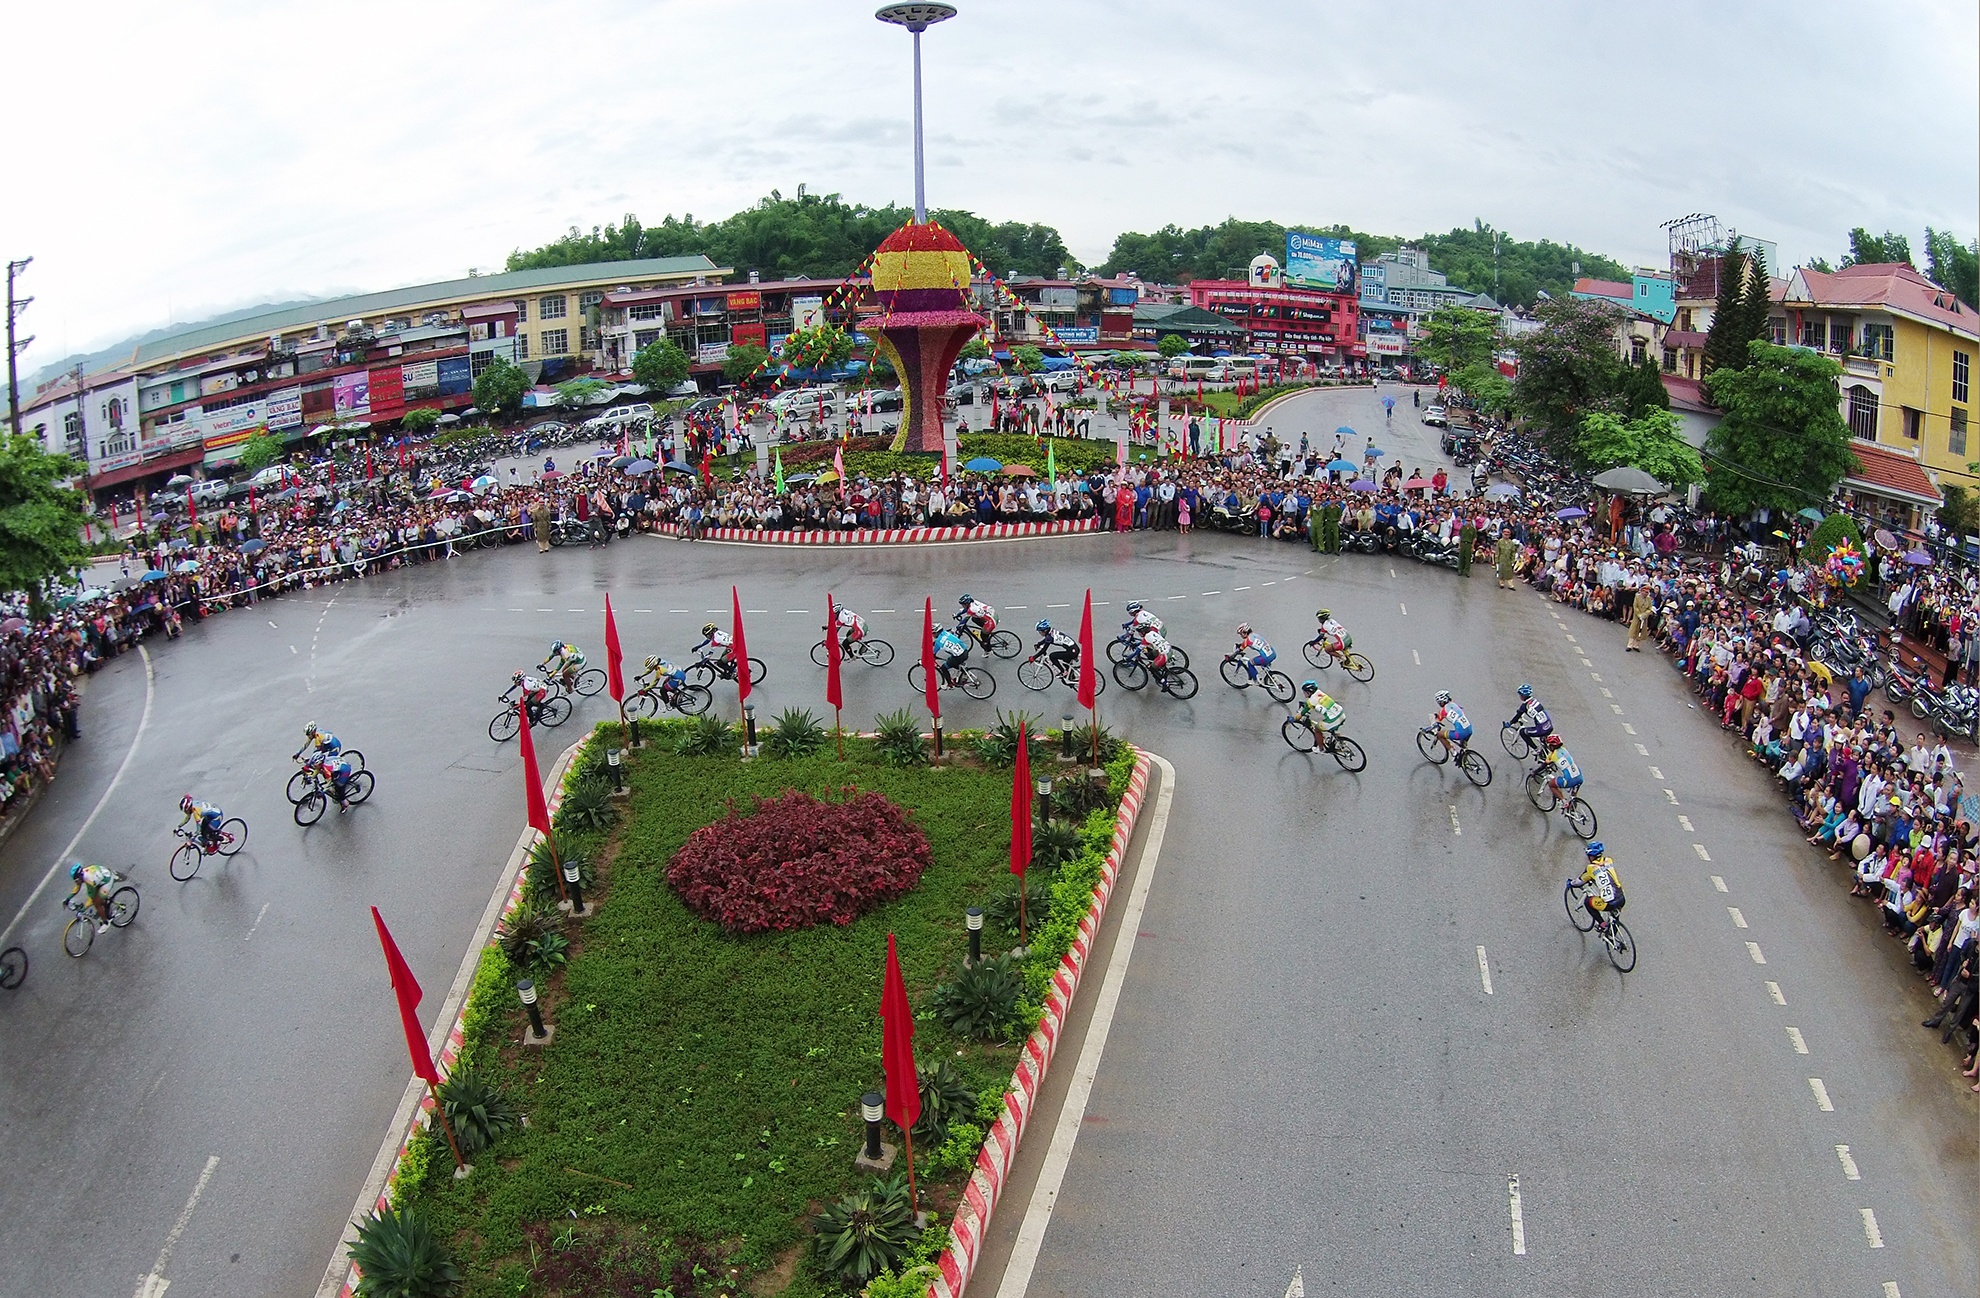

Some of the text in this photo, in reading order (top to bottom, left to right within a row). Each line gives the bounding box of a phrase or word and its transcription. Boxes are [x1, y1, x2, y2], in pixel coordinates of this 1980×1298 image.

[1302, 238, 1323, 249] MiMax
[213, 416, 248, 430] VietinBank
[1599, 874, 1608, 885] 26
[1602, 887, 1611, 897] 26
